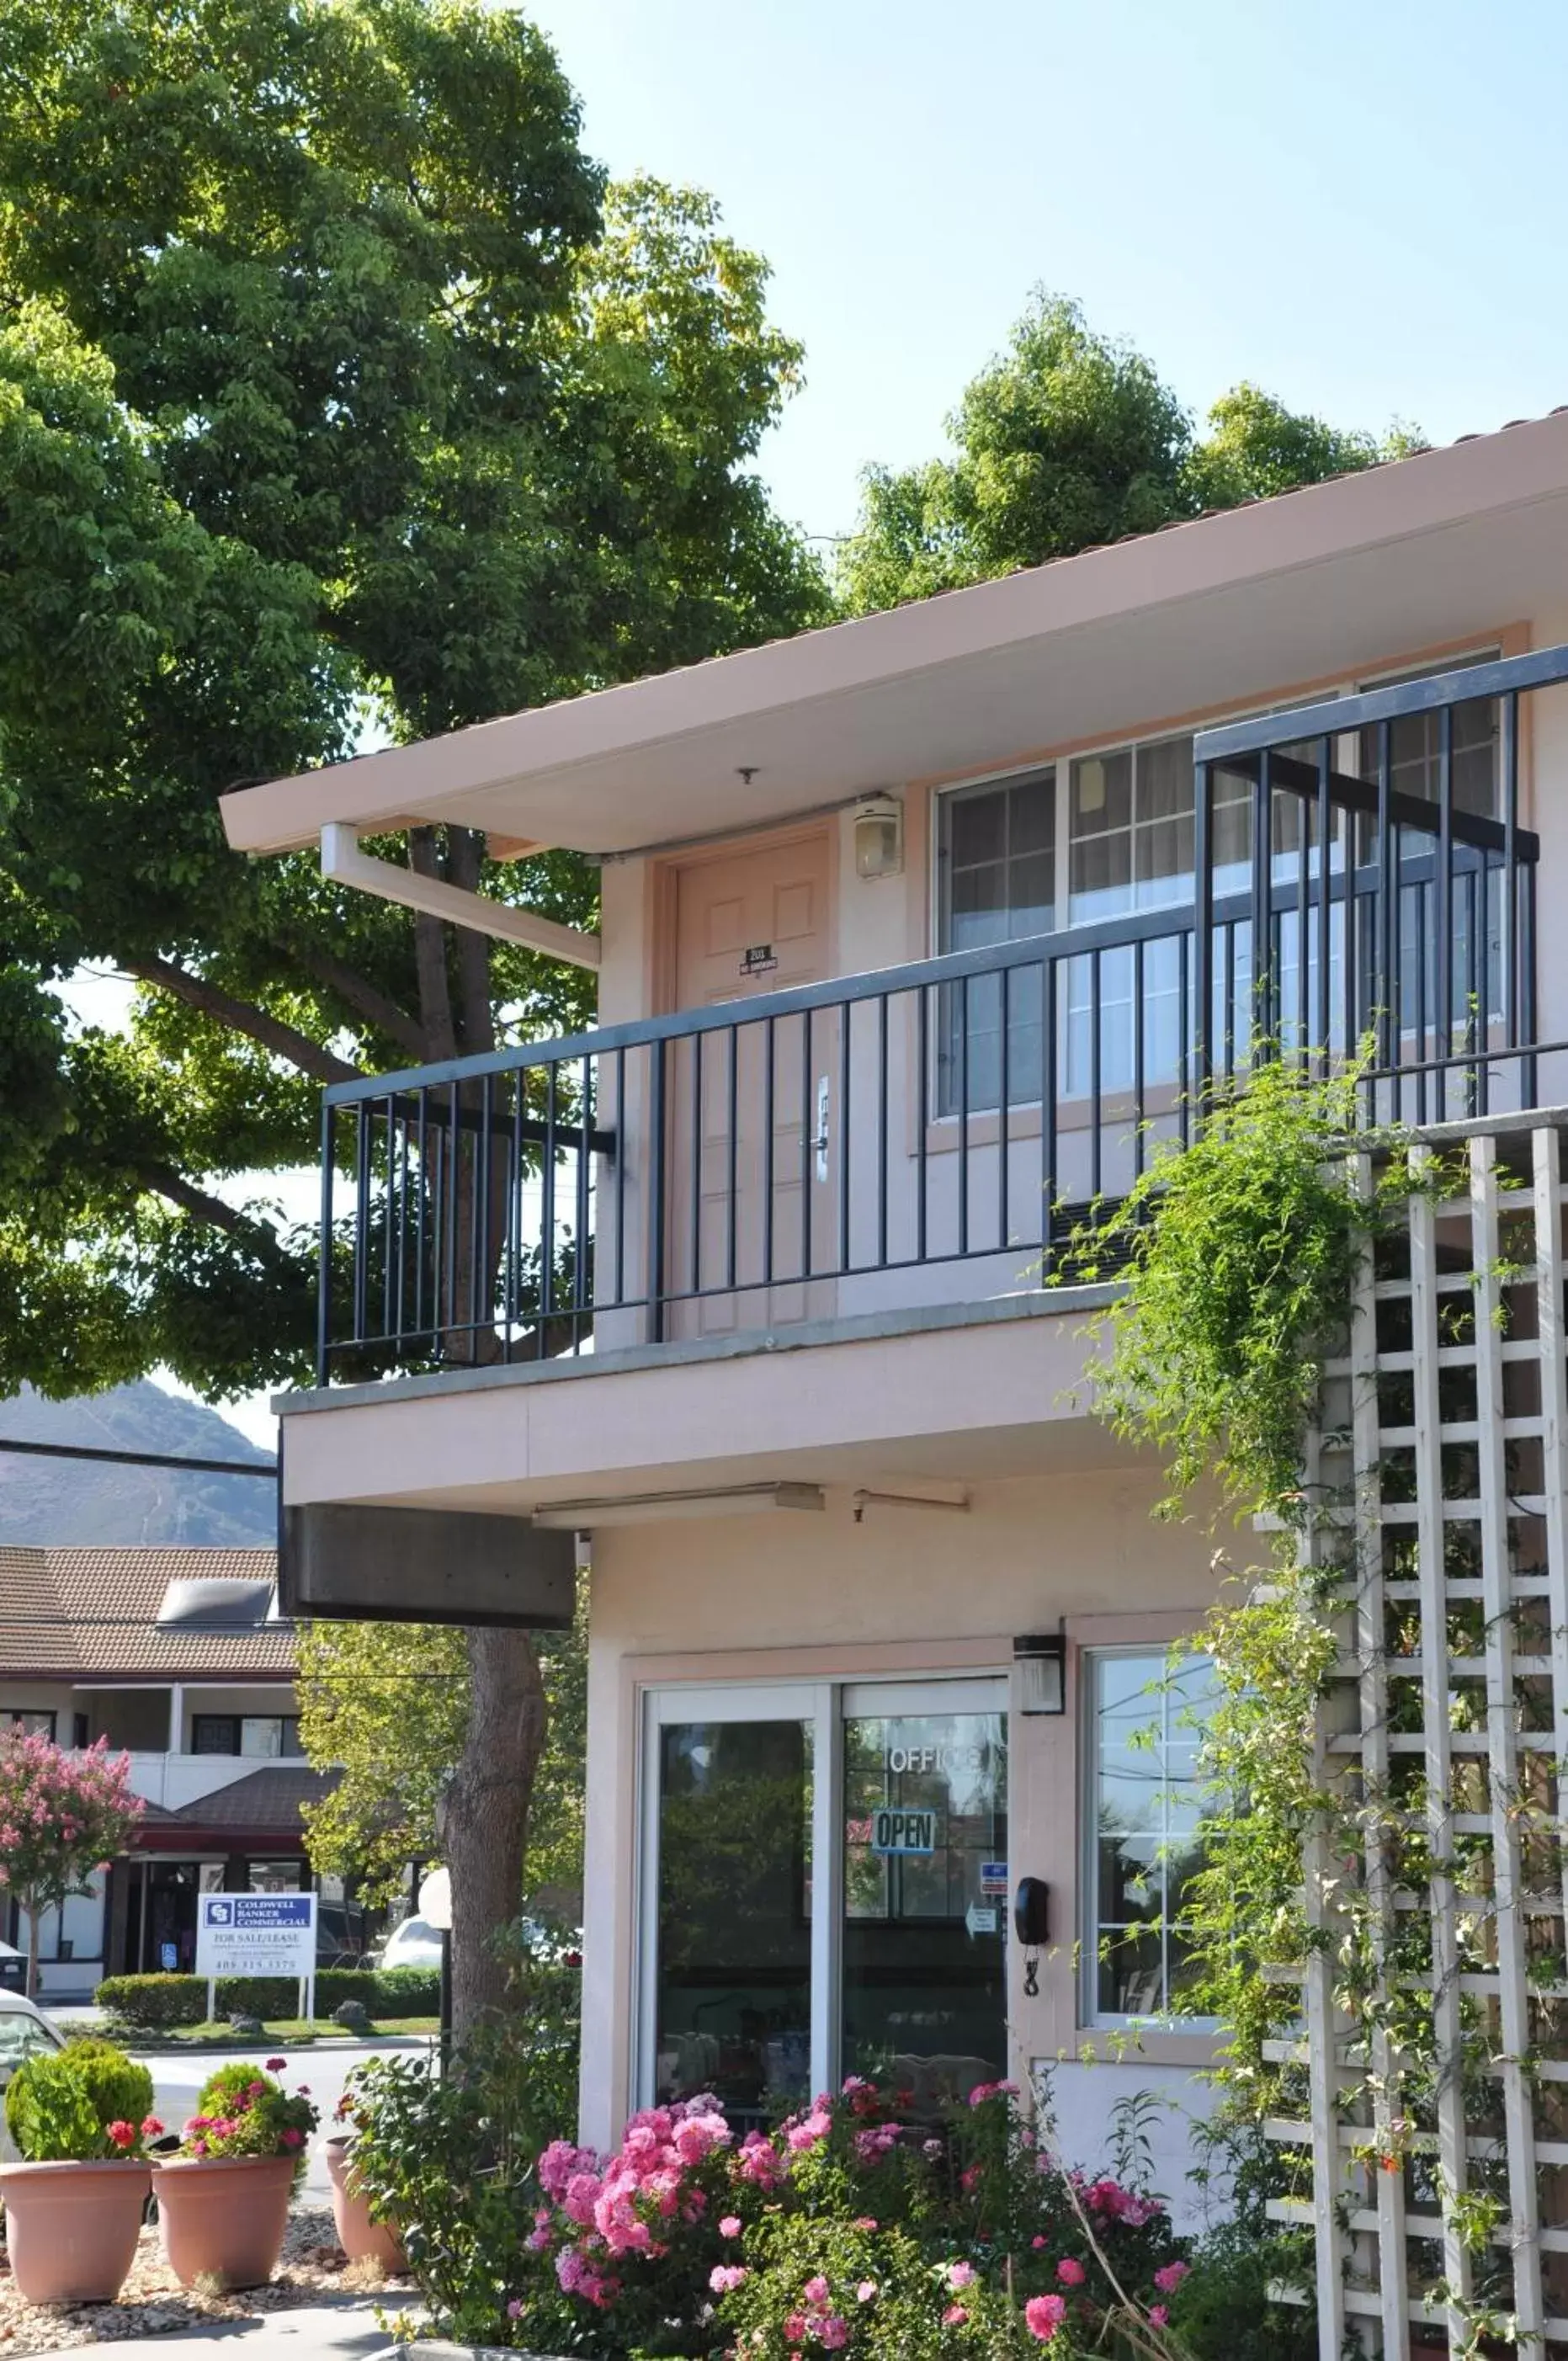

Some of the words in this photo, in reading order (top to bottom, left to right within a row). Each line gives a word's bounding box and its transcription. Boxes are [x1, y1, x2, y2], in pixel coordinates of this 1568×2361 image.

[877, 1813, 931, 1849] OPEN
[237, 1901, 296, 1909] COLDWELL
[237, 1910, 280, 1918] BANKER
[237, 1918, 306, 1927] COMMERCIAL
[214, 1933, 235, 1943] FOR
